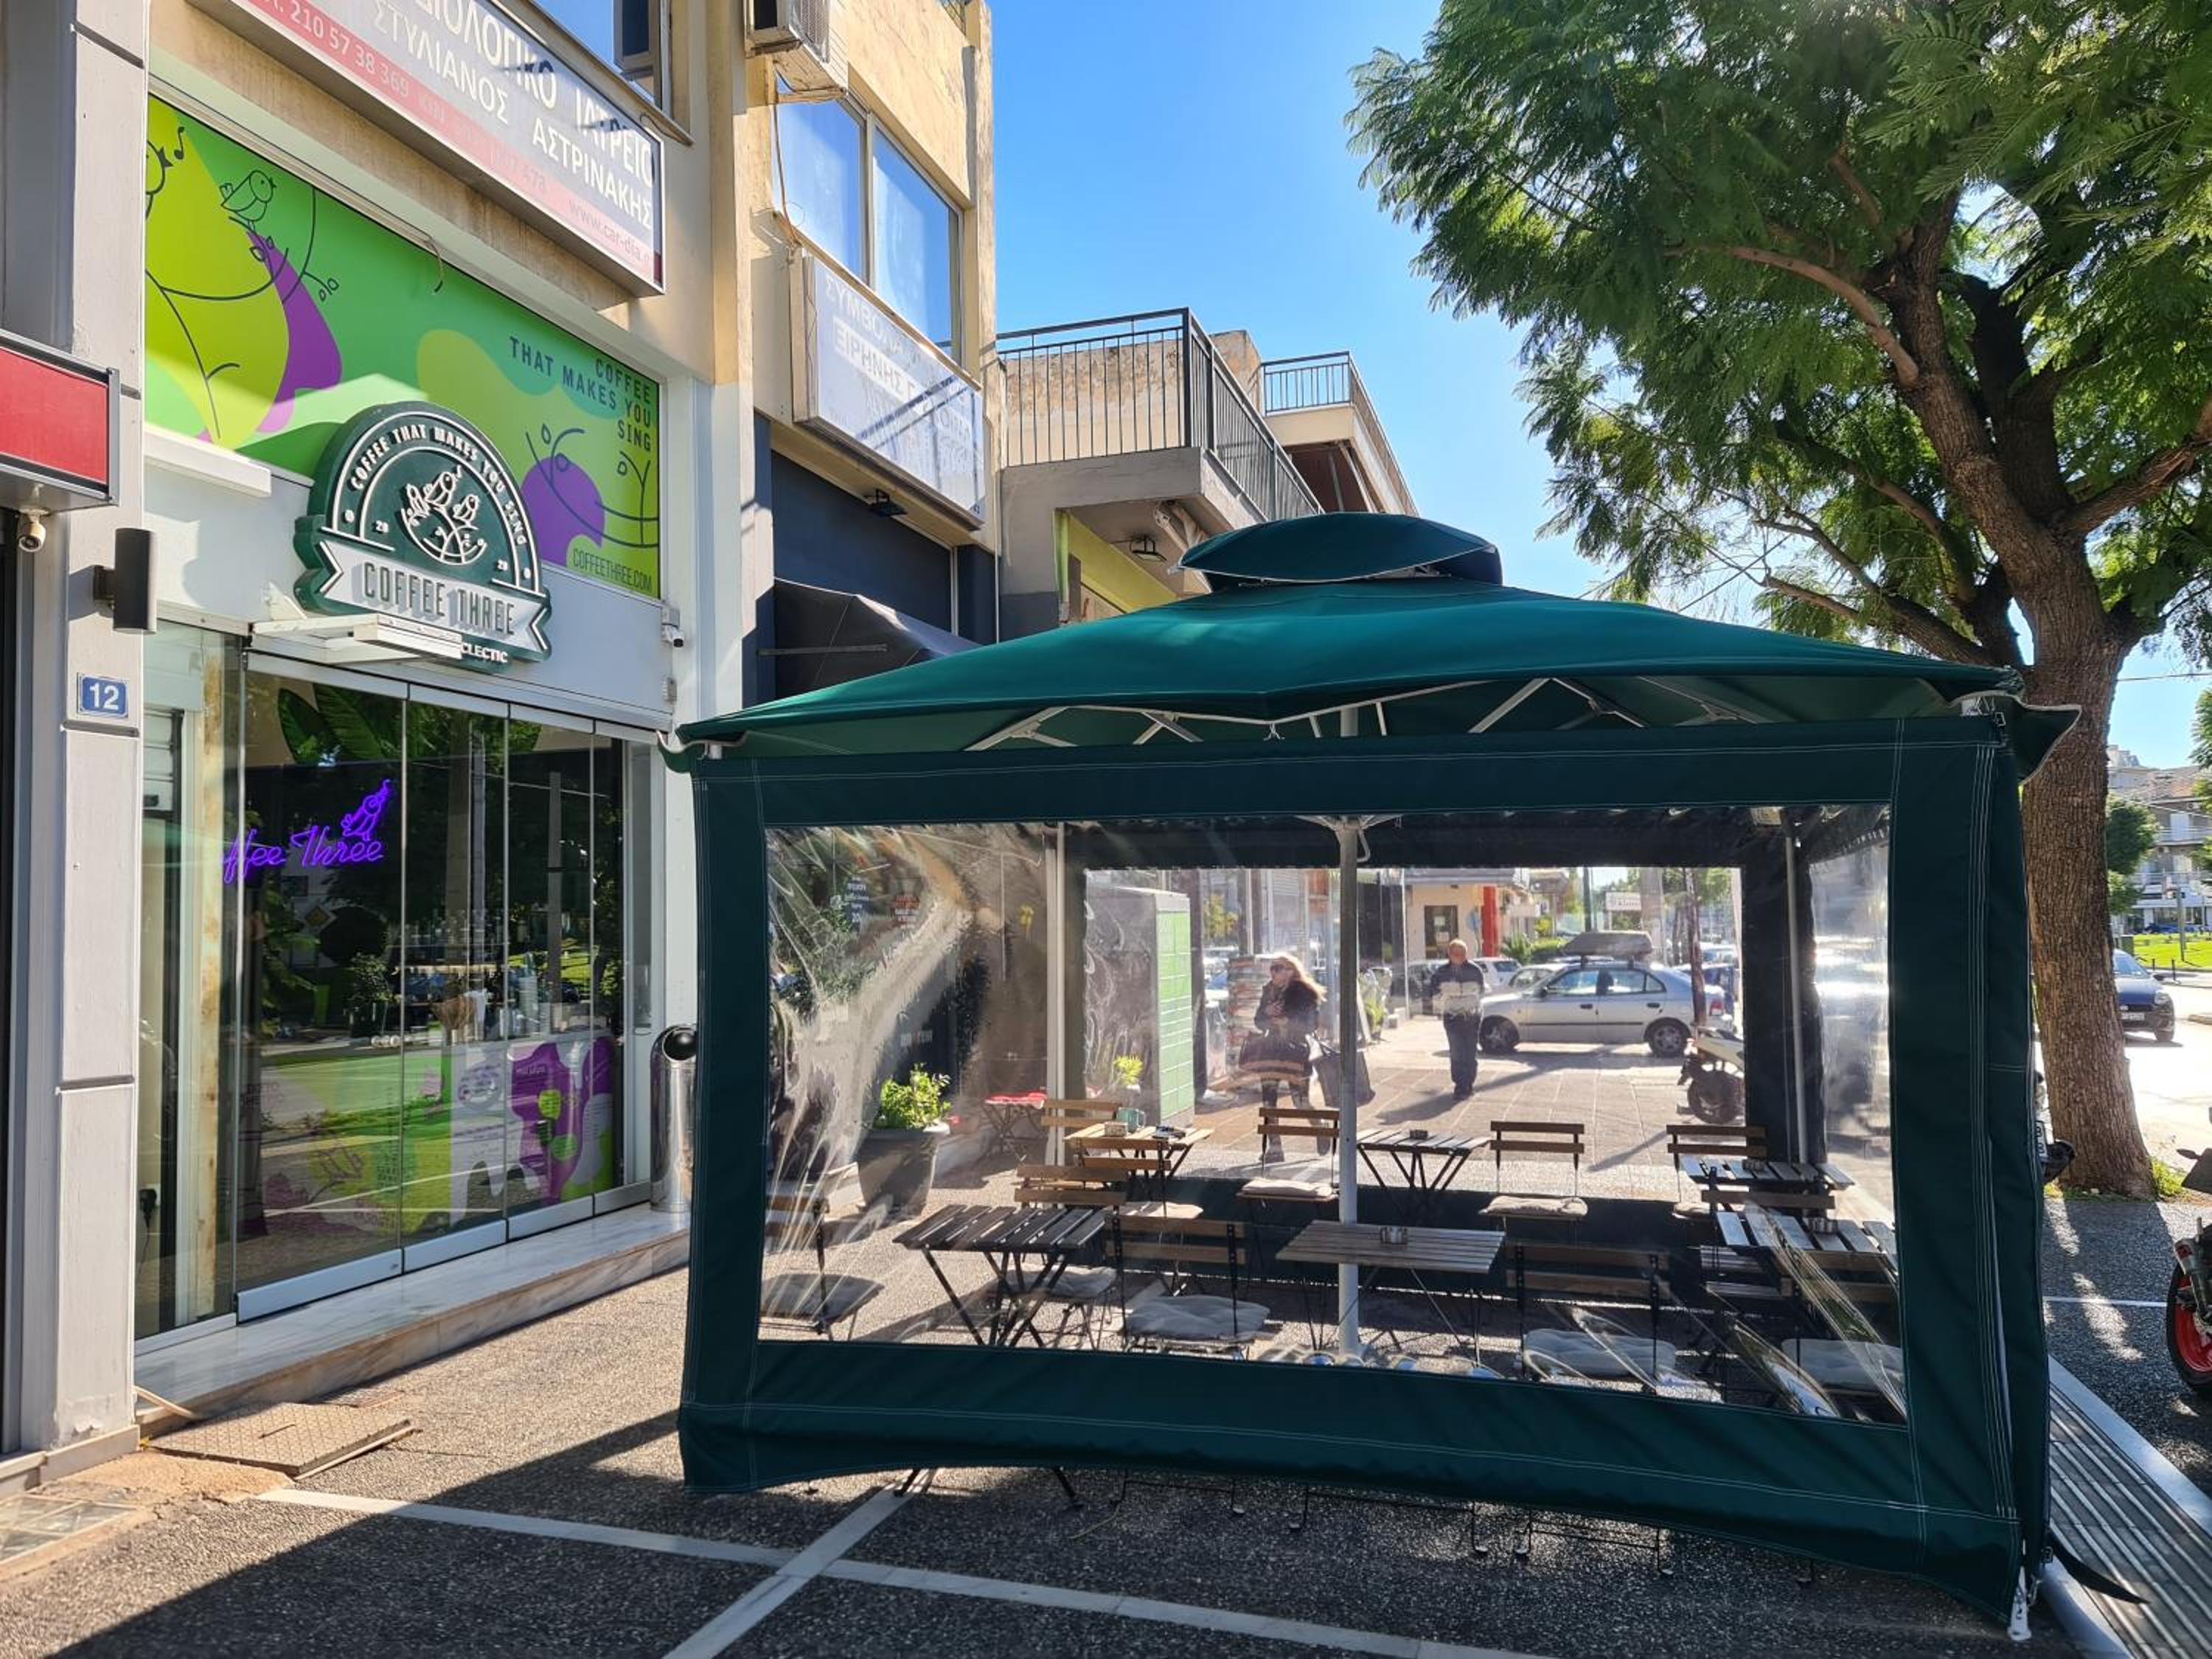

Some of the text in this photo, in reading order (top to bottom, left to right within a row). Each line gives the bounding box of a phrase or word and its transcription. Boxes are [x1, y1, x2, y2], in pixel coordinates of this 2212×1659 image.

[290, 1, 324, 38] 210
[329, 29, 351, 55] 57
[355, 44, 375, 73] 38
[373, 0, 653, 230] ΣΤΥΛΙΑΝΟΣ ΑΣΤΡΙΝΑΚΗΣ
[417, 0, 654, 188] ΟΛΟΓΙΚΟ ΙΑΤΡΕΙΟ
[509, 335, 651, 429] THAT MAKES YOU
[595, 358, 651, 406] COFFEE
[617, 418, 651, 452] SING
[350, 424, 527, 546] COFFEE THAT MAKES YOU SING
[364, 561, 515, 636] COFFEE THREE
[461, 641, 508, 664] CLECTIC
[89, 682, 119, 711] 12
[290, 824, 383, 868] Three
